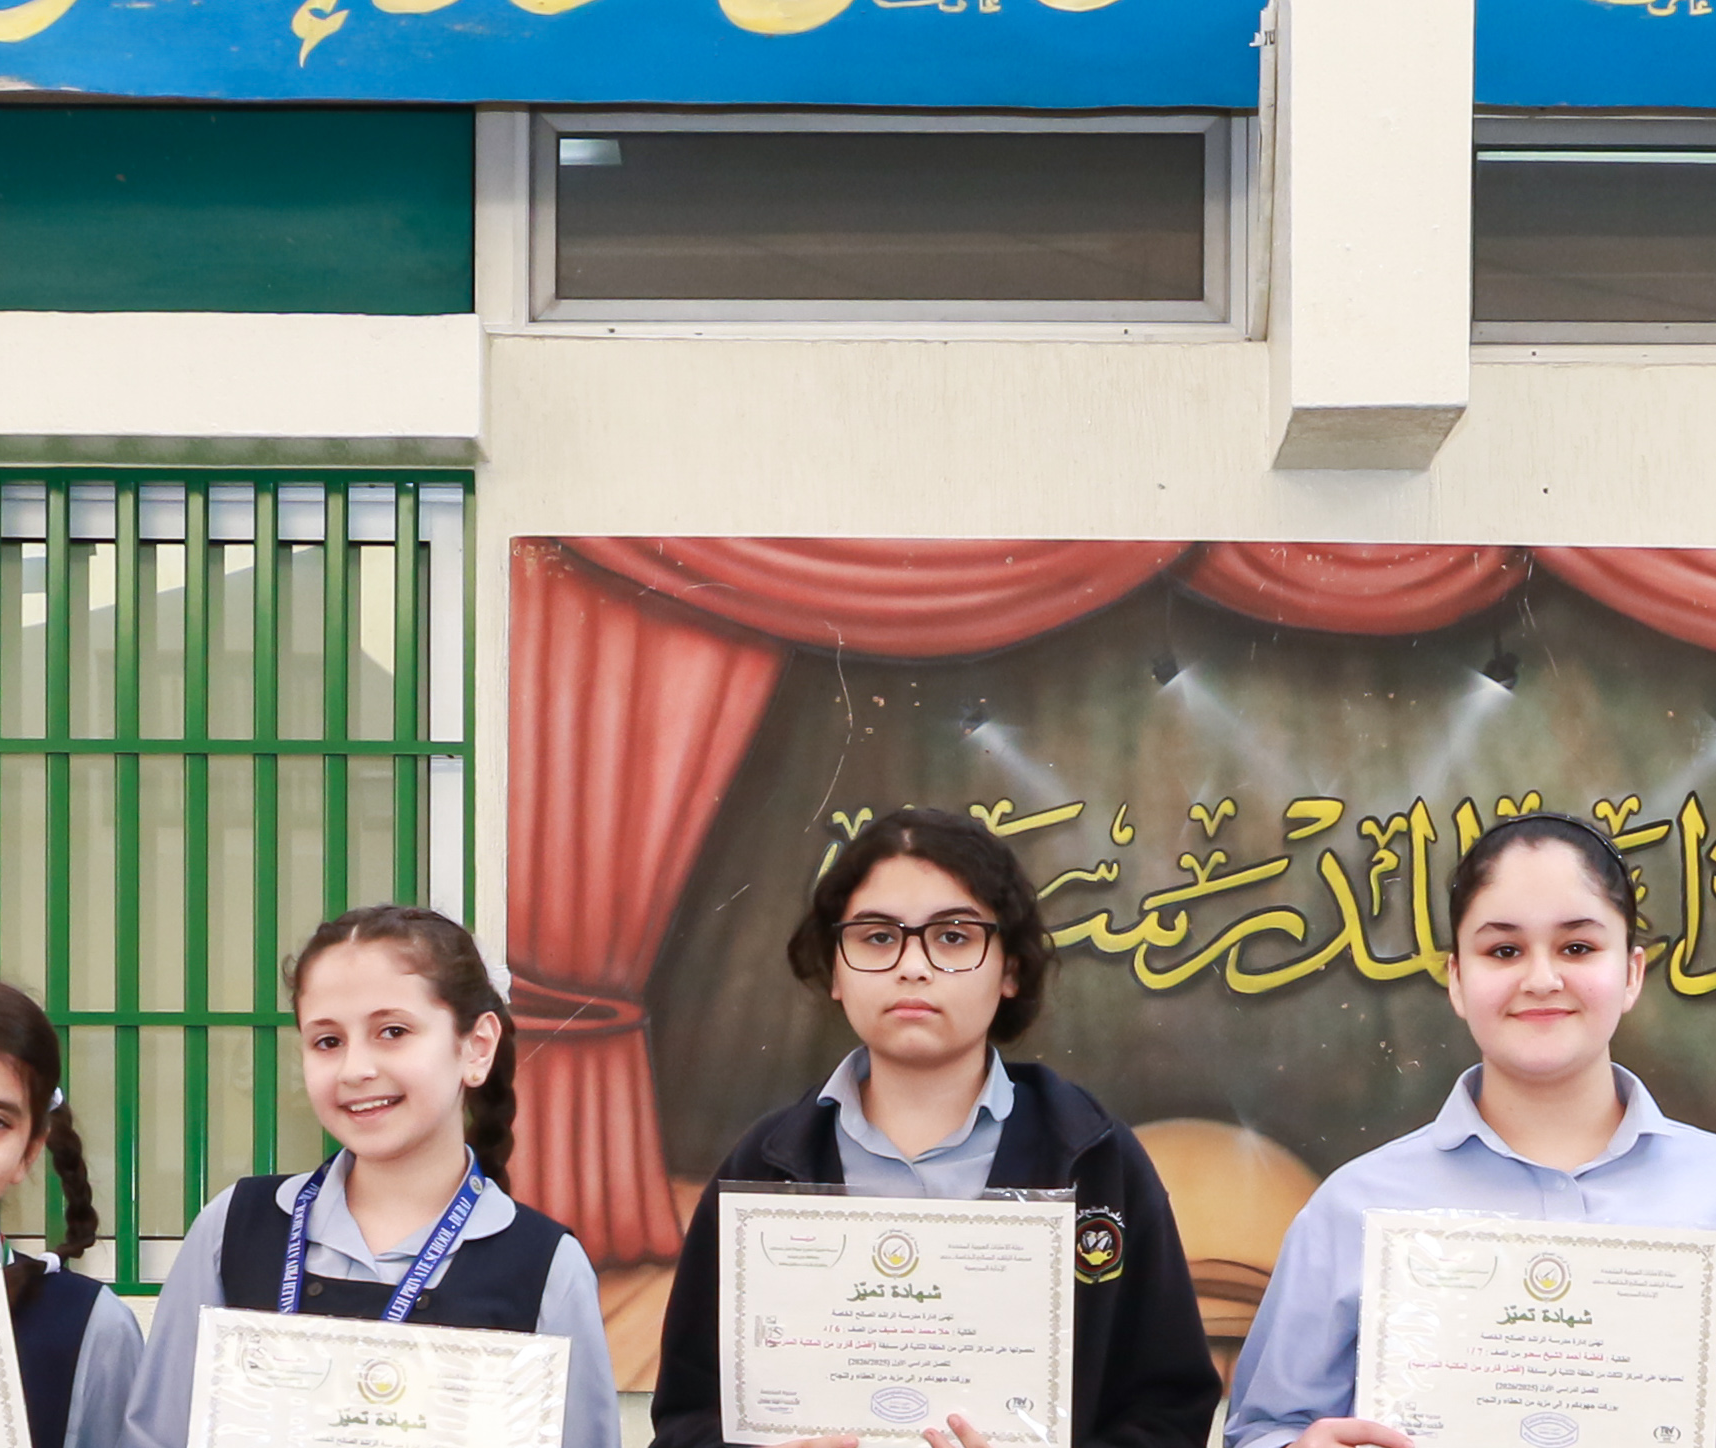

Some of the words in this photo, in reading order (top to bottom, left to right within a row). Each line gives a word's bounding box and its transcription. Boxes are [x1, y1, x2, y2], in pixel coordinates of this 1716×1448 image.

[400, 1259, 434, 1299] PRIVATE
[423, 1227, 456, 1261] SCHOOL
[448, 1196, 473, 1227] DUBAI
[283, 1239, 301, 1281] PRIVATE
[891, 1282, 942, 1302] شهادة
[1542, 1307, 1593, 1328] شهادة
[375, 1411, 427, 1432] شهادة
